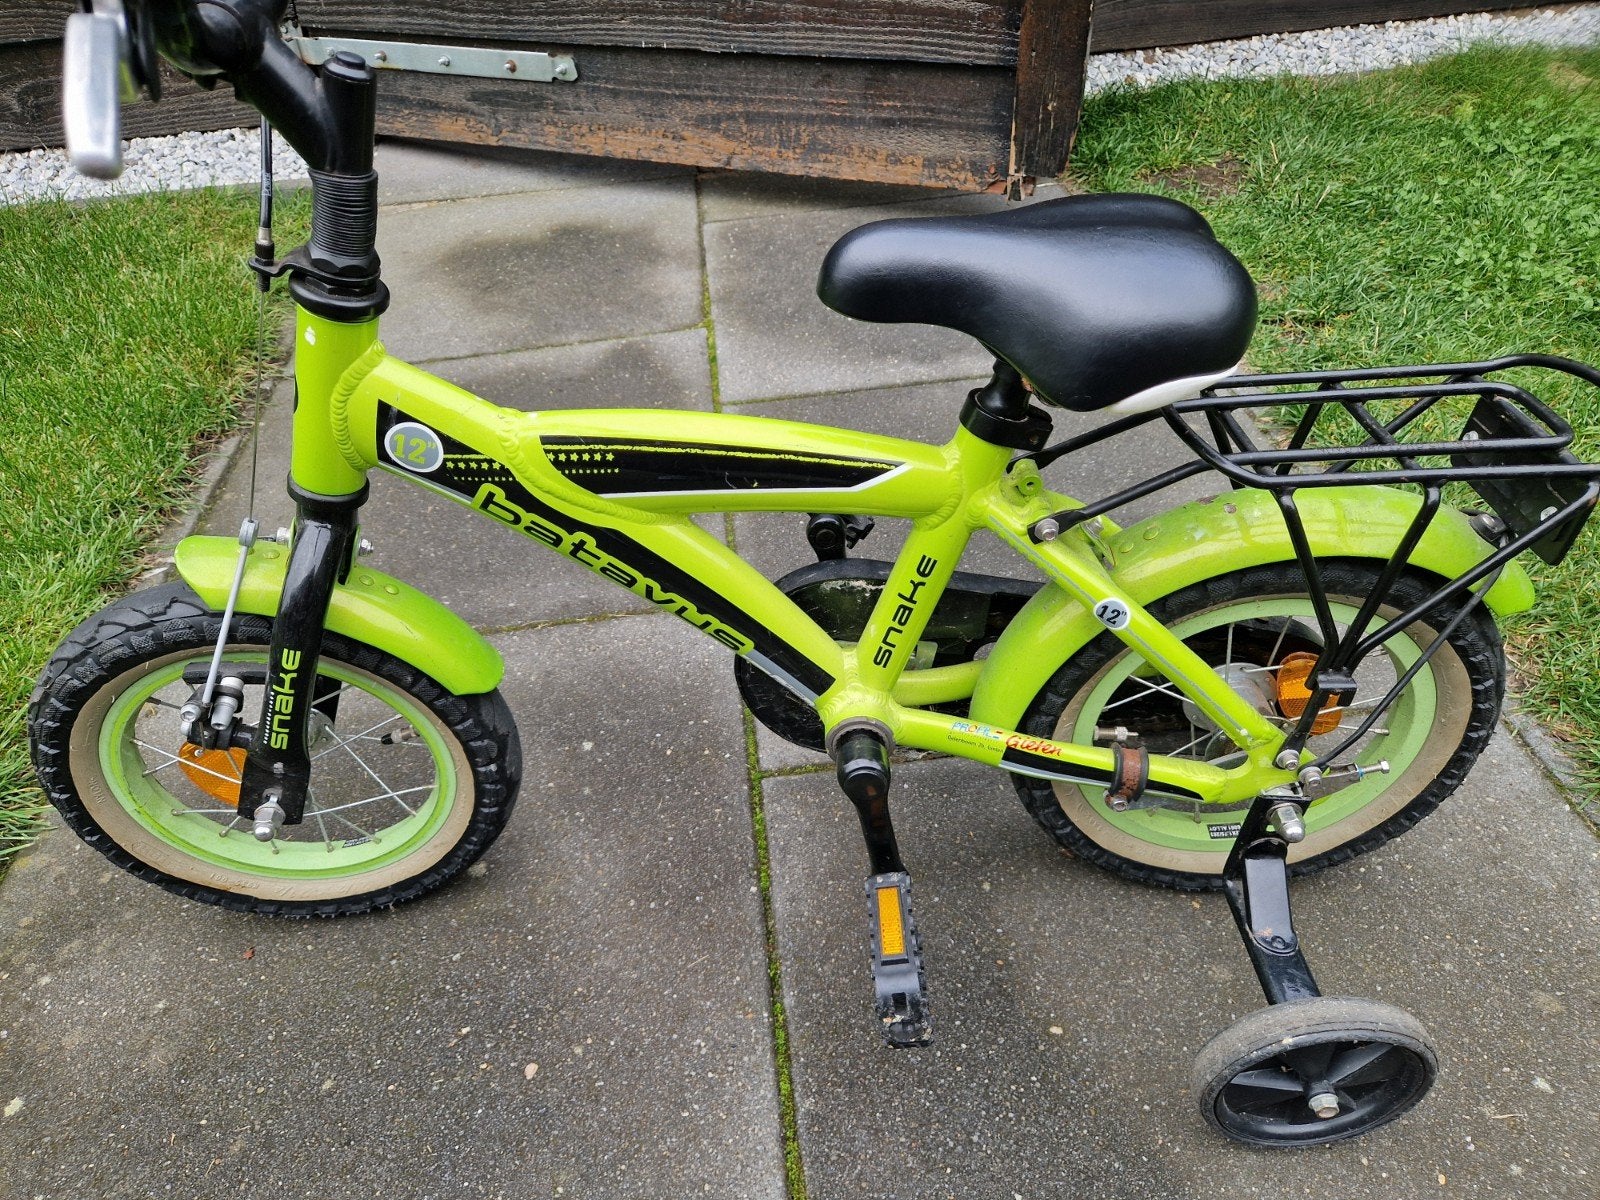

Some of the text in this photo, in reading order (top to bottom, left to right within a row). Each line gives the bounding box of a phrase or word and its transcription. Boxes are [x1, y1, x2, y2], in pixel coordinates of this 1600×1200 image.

[476, 487, 748, 653] batavus
[873, 554, 938, 669] snake
[270, 647, 302, 750] snake
